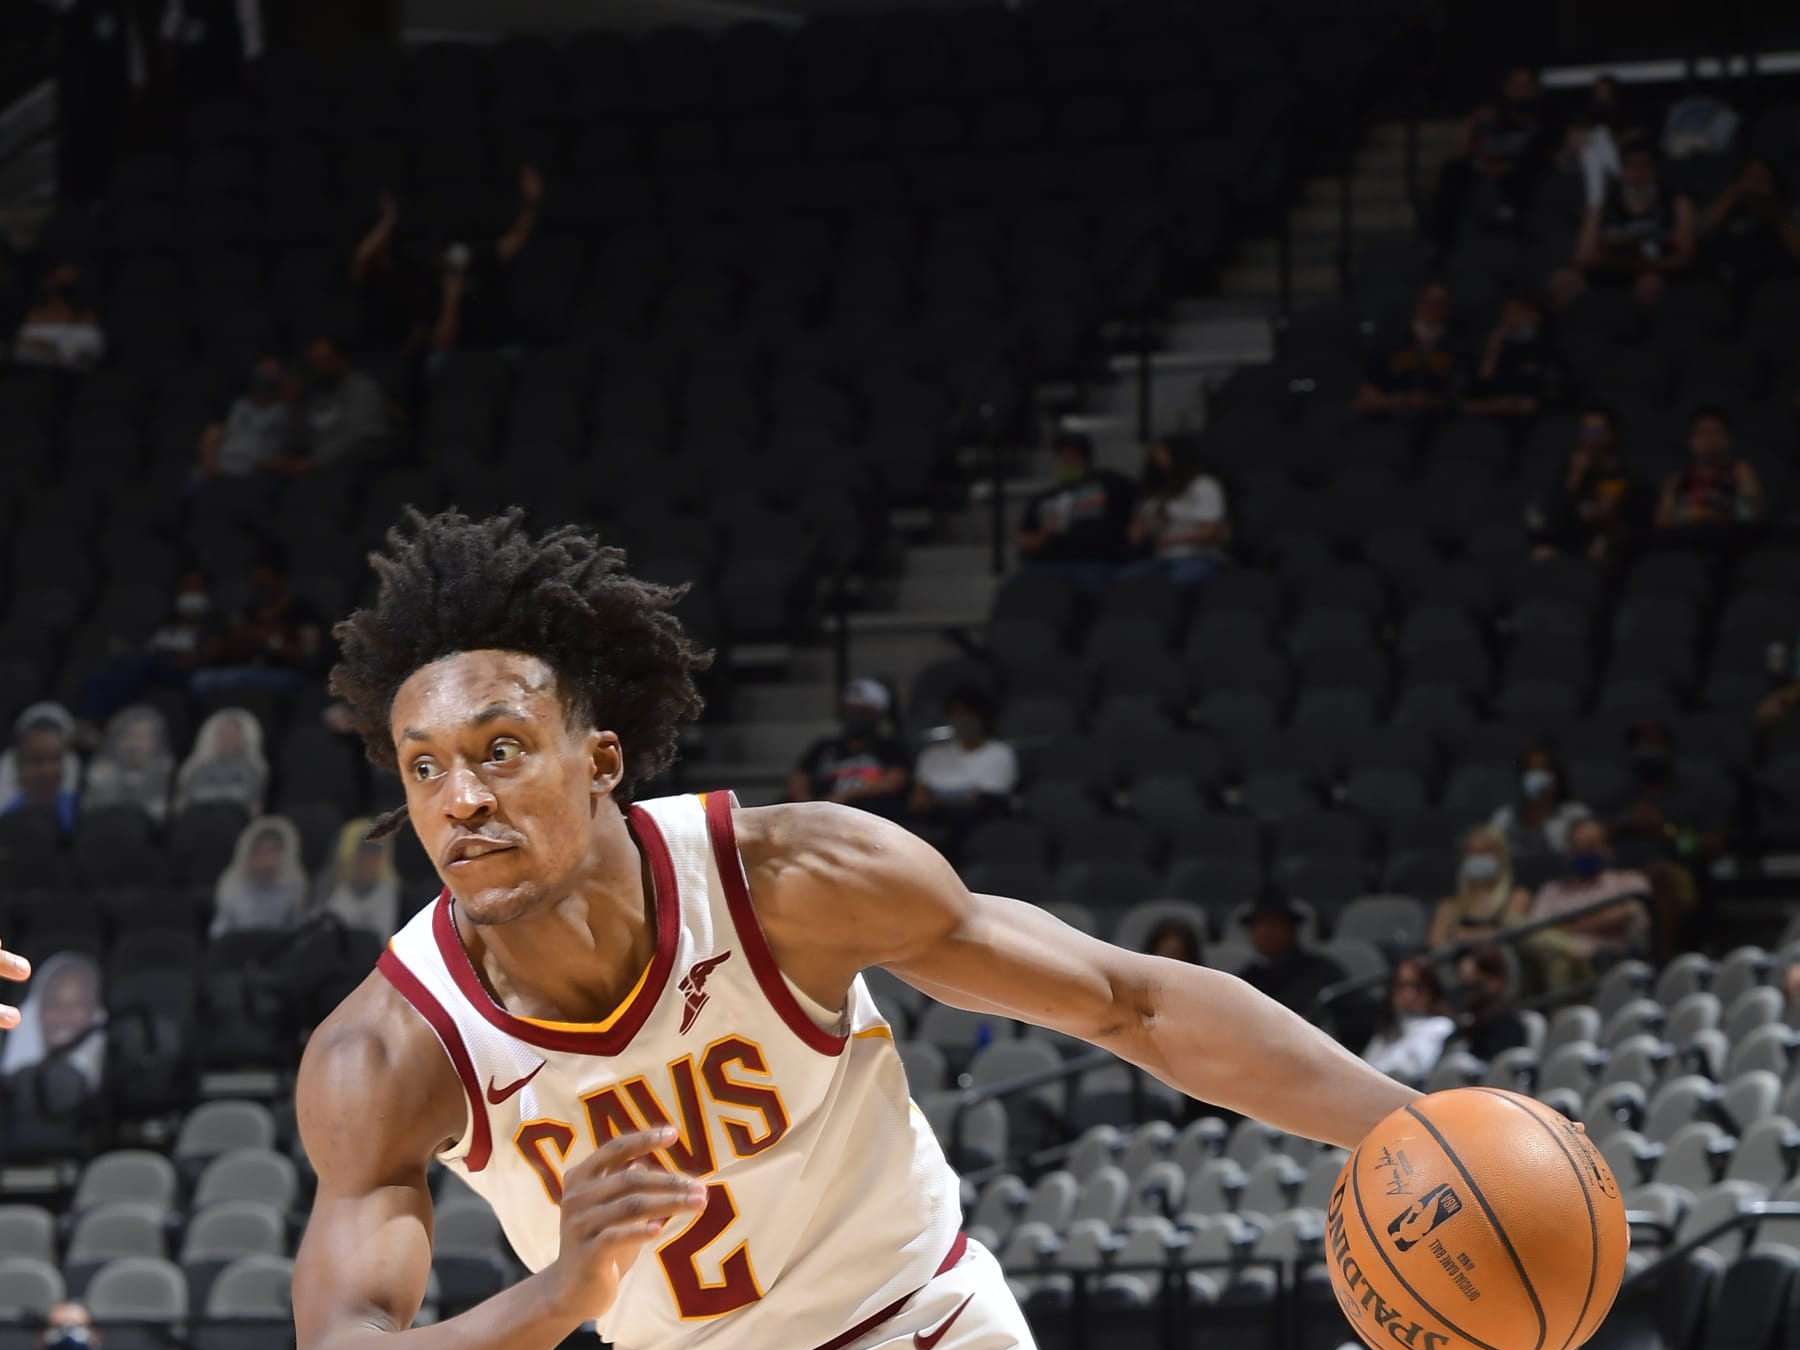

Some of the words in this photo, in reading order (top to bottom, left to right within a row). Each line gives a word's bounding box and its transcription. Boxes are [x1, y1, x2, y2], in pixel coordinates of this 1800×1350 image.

[512, 1033, 792, 1207] CAVS
[1441, 1192, 1461, 1215] NBA
[652, 1181, 764, 1322] 2
[1428, 1238, 1447, 1259] BALL
[1439, 1254, 1460, 1276] GAME
[1453, 1272, 1481, 1302] OFFICIAL
